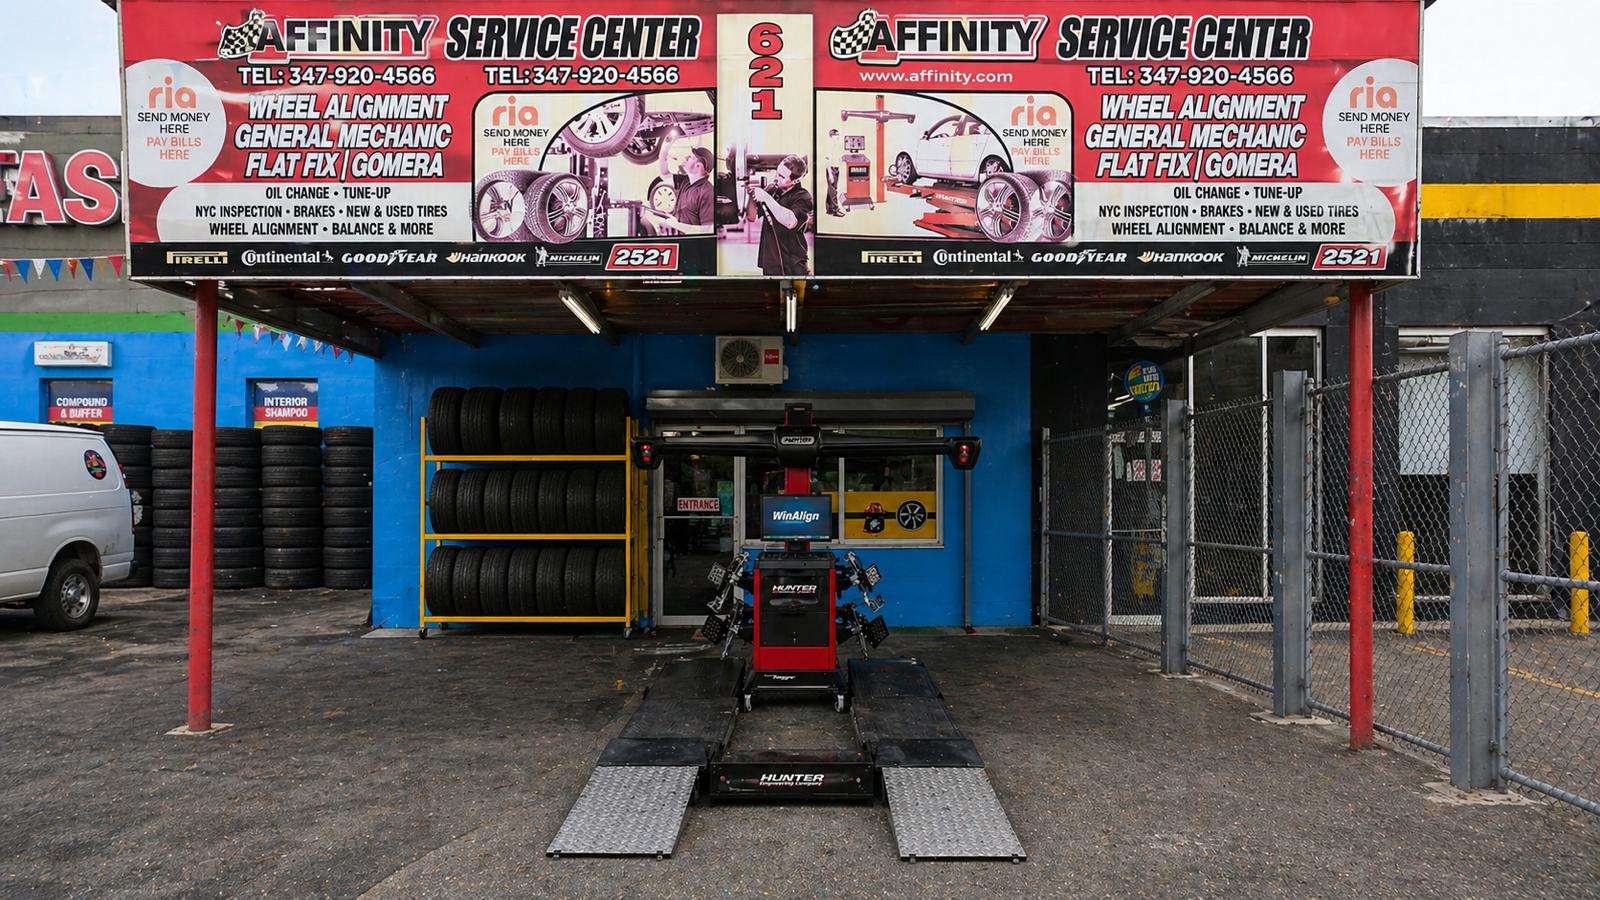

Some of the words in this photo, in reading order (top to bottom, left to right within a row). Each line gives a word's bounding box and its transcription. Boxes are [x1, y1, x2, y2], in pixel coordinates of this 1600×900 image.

[254, 19, 431, 53] AFFINITY
[446, 16, 577, 59] SERVICE
[582, 16, 701, 59] CENTER
[868, 19, 1040, 53] AFFINITY
[1057, 16, 1191, 59] SERVICE
[1194, 16, 1311, 59] CENTER
[238, 67, 284, 84] TEL:
[288, 67, 435, 85] 347-920-4566
[748, 22, 783, 120] 621
[1087, 67, 1134, 85] TEL:
[1139, 67, 1294, 85] 347-920-4566
[859, 70, 1013, 86] www.affinity.com
[148, 76, 196, 109] ria
[1349, 76, 1398, 109] ria
[248, 94, 321, 120] WHEEL
[322, 94, 449, 120] ALIGNMENT
[492, 95, 539, 126] ria
[1011, 95, 1057, 126] ria
[1101, 94, 1177, 120] WHEEL
[1178, 94, 1307, 120] ALIGNMENT
[137, 112, 168, 122] SEND
[170, 112, 210, 122] MONEY
[1338, 112, 1368, 122] SEND
[1370, 112, 1410, 122] MONEY
[160, 124, 190, 134] HERE
[483, 128, 510, 137] SEND
[513, 128, 549, 137] MONEY
[1002, 128, 1030, 137] SEND
[1031, 128, 1068, 137] MONEY
[1360, 124, 1390, 134] HERE
[147, 137, 168, 147] PAY
[171, 137, 201, 147] BILLS
[235, 124, 336, 149] GENERAL
[337, 124, 452, 149] MECHANIC
[503, 138, 530, 147] HERE
[1023, 138, 1050, 147] HERE
[1085, 124, 1187, 149] GENERAL
[1189, 124, 1307, 149] MECHANIC
[1346, 137, 1368, 147] PAY
[1370, 137, 1401, 147] BILLS
[160, 149, 190, 160] HERE
[491, 147, 511, 156] PAY
[1010, 147, 1031, 156] PAY
[1033, 147, 1060, 156] BILLS
[1360, 149, 1390, 160] HERE
[246, 153, 301, 178] FLAT
[302, 153, 338, 178] FIX
[351, 153, 444, 178] GOMERA
[503, 156, 530, 166] HERE
[1023, 156, 1050, 166] HERE
[1096, 153, 1153, 178] FLAT
[1154, 153, 1193, 178] FIX
[1205, 153, 1298, 178] GOMERA
[265, 187, 282, 199] OIL
[285, 187, 330, 199] CHANGE
[342, 187, 391, 199] TUNE-UP
[1173, 187, 1192, 199] OIL
[1194, 187, 1240, 199] CHANGE
[1253, 187, 1303, 199] TUNE-UP
[195, 206, 217, 218] NYC
[220, 206, 282, 218] INSPECTION
[293, 206, 335, 218] BRAKES
[346, 206, 370, 218] NEW
[374, 206, 382, 218] &
[386, 206, 413, 218] USED
[415, 206, 447, 218] TIRES
[1099, 206, 1121, 218] NYC
[1124, 206, 1189, 218] INSPECTION
[1200, 206, 1244, 218] BRAKES
[1255, 206, 1280, 218] NEW
[1284, 206, 1292, 218] &
[1295, 206, 1324, 218] USED
[1327, 206, 1359, 218] TIRES
[209, 223, 248, 235] WHEEL
[251, 223, 319, 235] ALIGNMENT
[332, 223, 385, 235] BALANCE
[388, 223, 397, 235] &
[400, 223, 434, 235] MORE
[1111, 223, 1153, 235] WHEEL
[1156, 223, 1225, 235] ALIGNMENT
[1239, 223, 1295, 235] BALANCE
[1298, 223, 1307, 235] &
[1311, 223, 1346, 235] MORE
[166, 251, 229, 265] PIRELLI
[241, 249, 321, 266] Continental
[341, 250, 437, 265] GOODYEAR
[614, 249, 671, 265] 2521
[861, 251, 923, 264] PIRELLI
[933, 249, 1011, 266] Continental
[1031, 250, 1127, 265] GOODYEAR
[1251, 253, 1306, 262] MICHELIN
[1321, 249, 1380, 265] 2521
[56, 398, 108, 407] COMPOUND
[264, 397, 308, 406] INTERIOR
[265, 407, 308, 417] SHAMPOO
[678, 499, 719, 510] ENTRANCE
[772, 511, 820, 523] WinAlign
[760, 773, 825, 782] HUNTER
